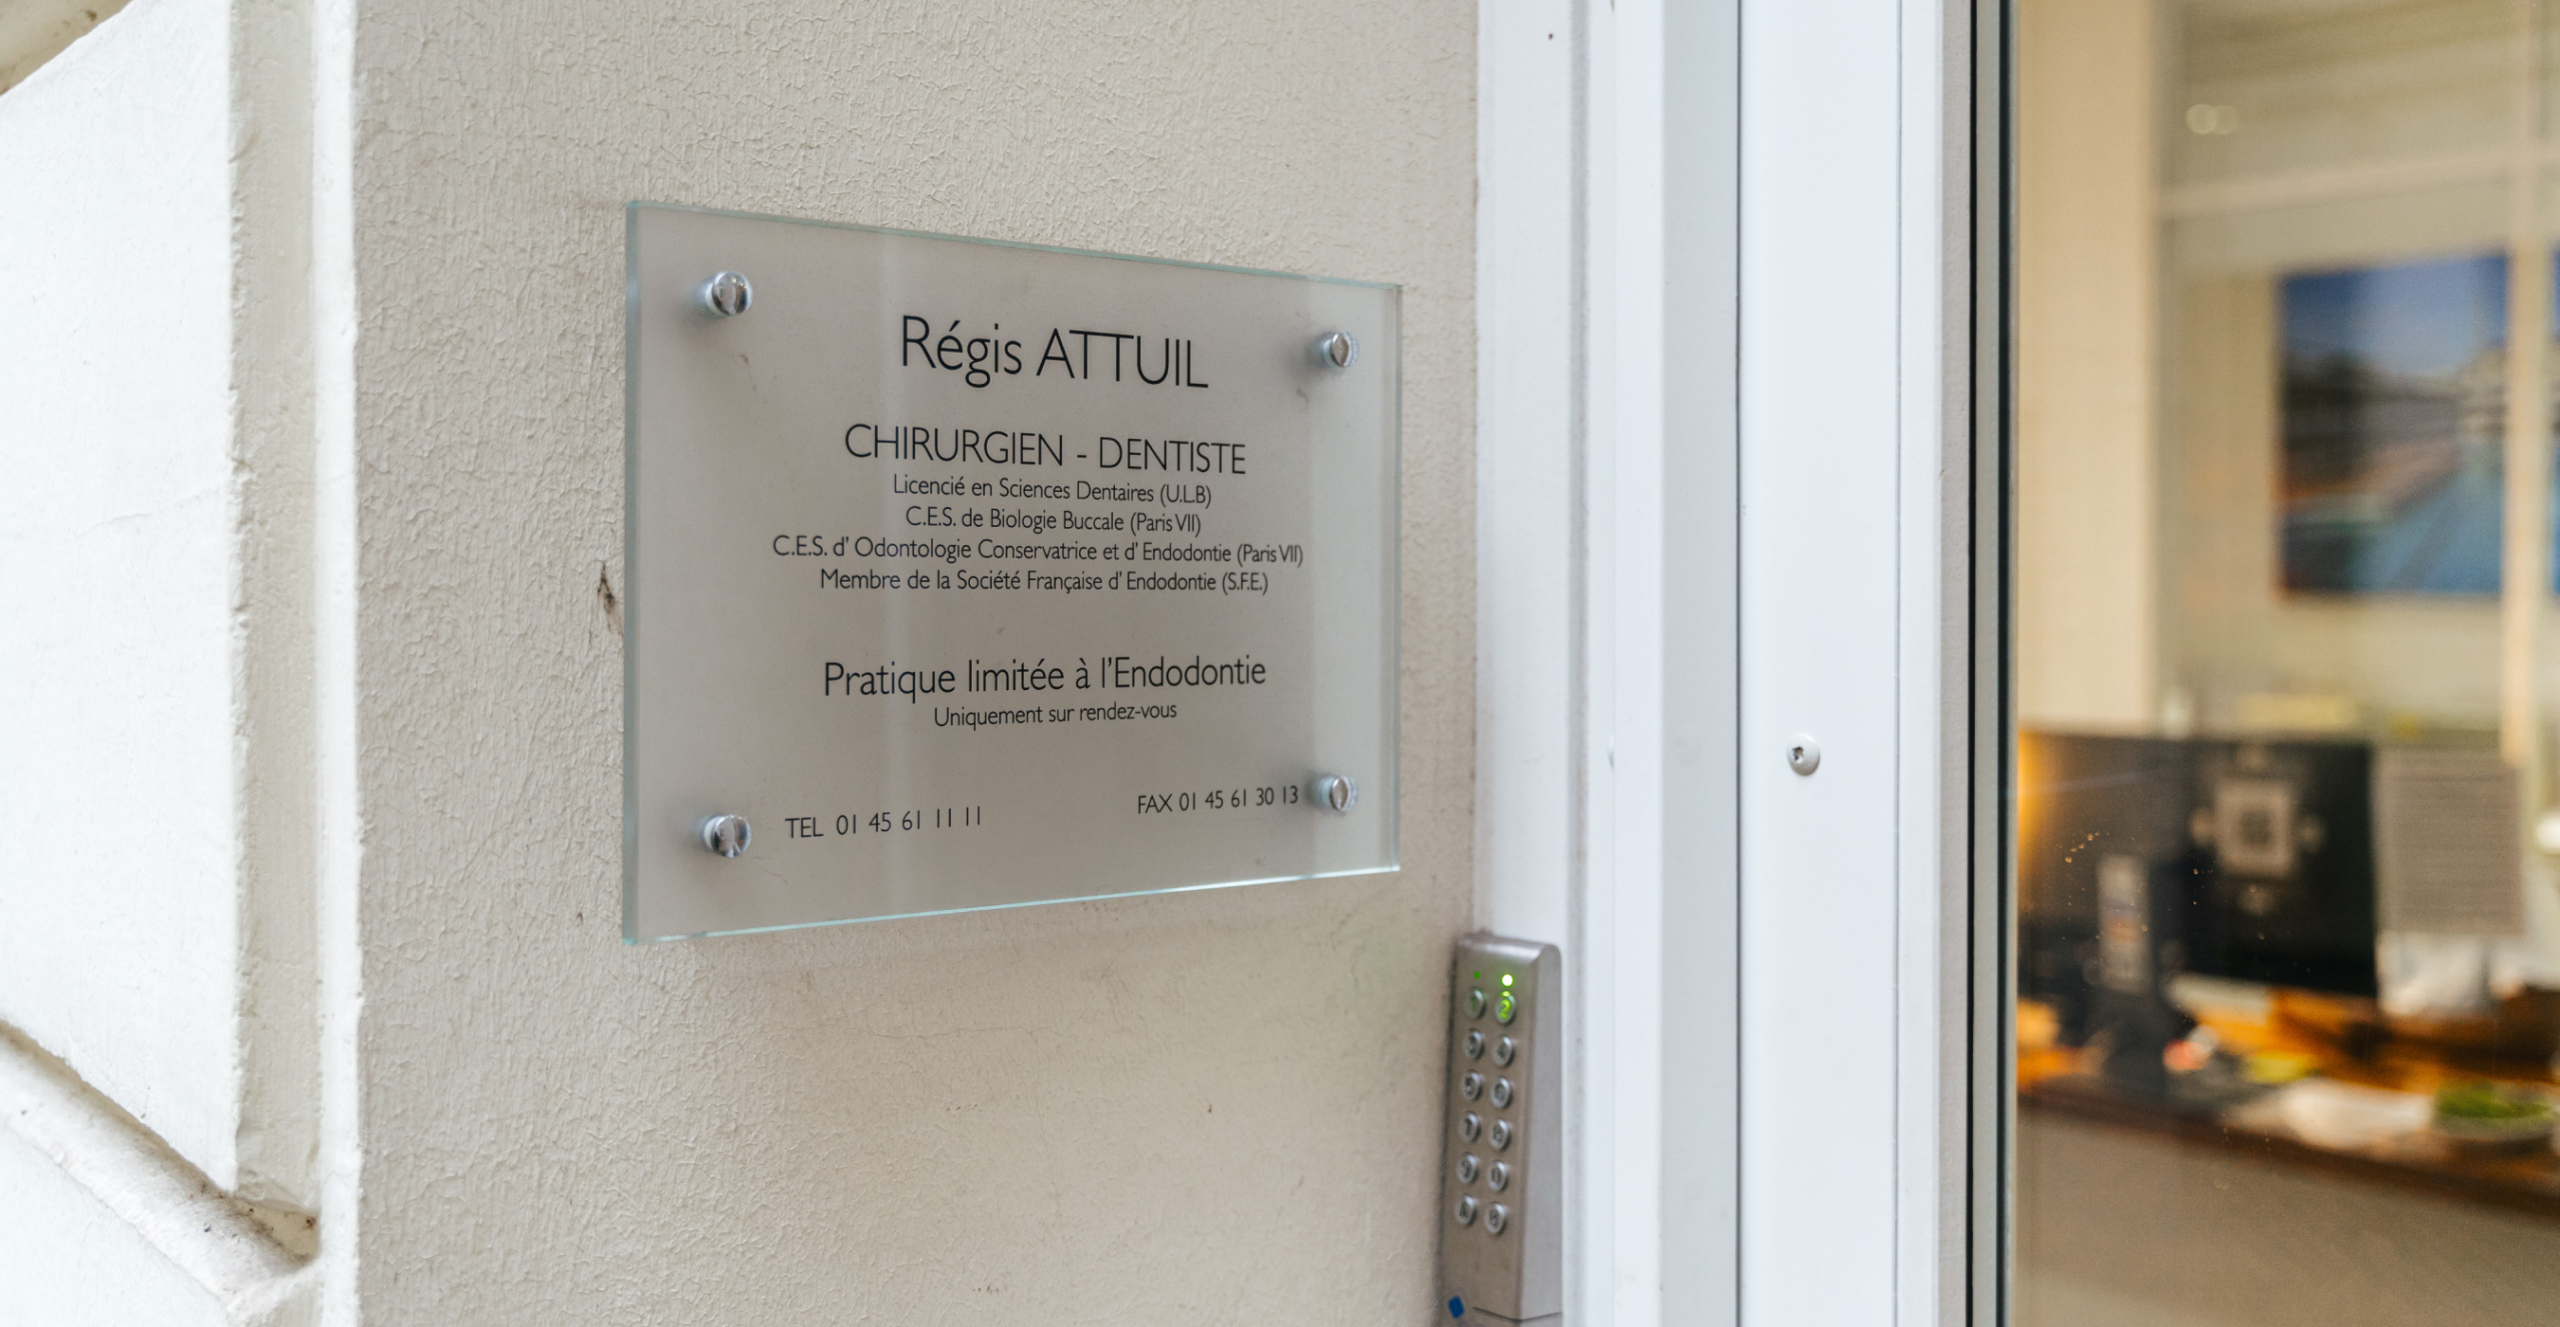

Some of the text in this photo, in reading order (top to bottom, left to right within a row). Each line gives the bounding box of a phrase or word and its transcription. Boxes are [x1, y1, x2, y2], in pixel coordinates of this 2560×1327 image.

[902, 314, 1210, 389] Régis ATTUIL
[844, 422, 1063, 467] CHIRURGIEN
[1099, 436, 1247, 475] DENTISTE
[893, 473, 1212, 510] Licencié en Sciences Dentaires (U.L.B)
[905, 505, 957, 527] C.E.S.
[961, 507, 984, 528] de
[990, 507, 1057, 535] Biologie
[1063, 509, 1125, 531] Buccale
[772, 534, 828, 557] C.E.S.
[854, 535, 972, 565] Odontologie
[977, 538, 1098, 561] Conservatrice
[1102, 543, 1120, 561] et
[1142, 541, 1232, 563] Endodontie
[820, 567, 901, 590] Membre
[906, 569, 931, 590] de
[936, 569, 952, 590] la
[956, 568, 1021, 590] Société
[1027, 569, 1103, 595] Française
[1126, 570, 1217, 591] Endodontie
[1221, 571, 1269, 596] (S.F.E.)
[824, 660, 956, 705] Pratique
[968, 657, 1065, 693] limitée
[1075, 657, 1092, 690] à
[934, 700, 1178, 732] Uniquement sur rendez-vous
[1137, 784, 1299, 815] FAX 01 45 61 30 13
[784, 805, 981, 839] TEL 01 45 61 11 11
[1499, 998, 1512, 1020] 2
